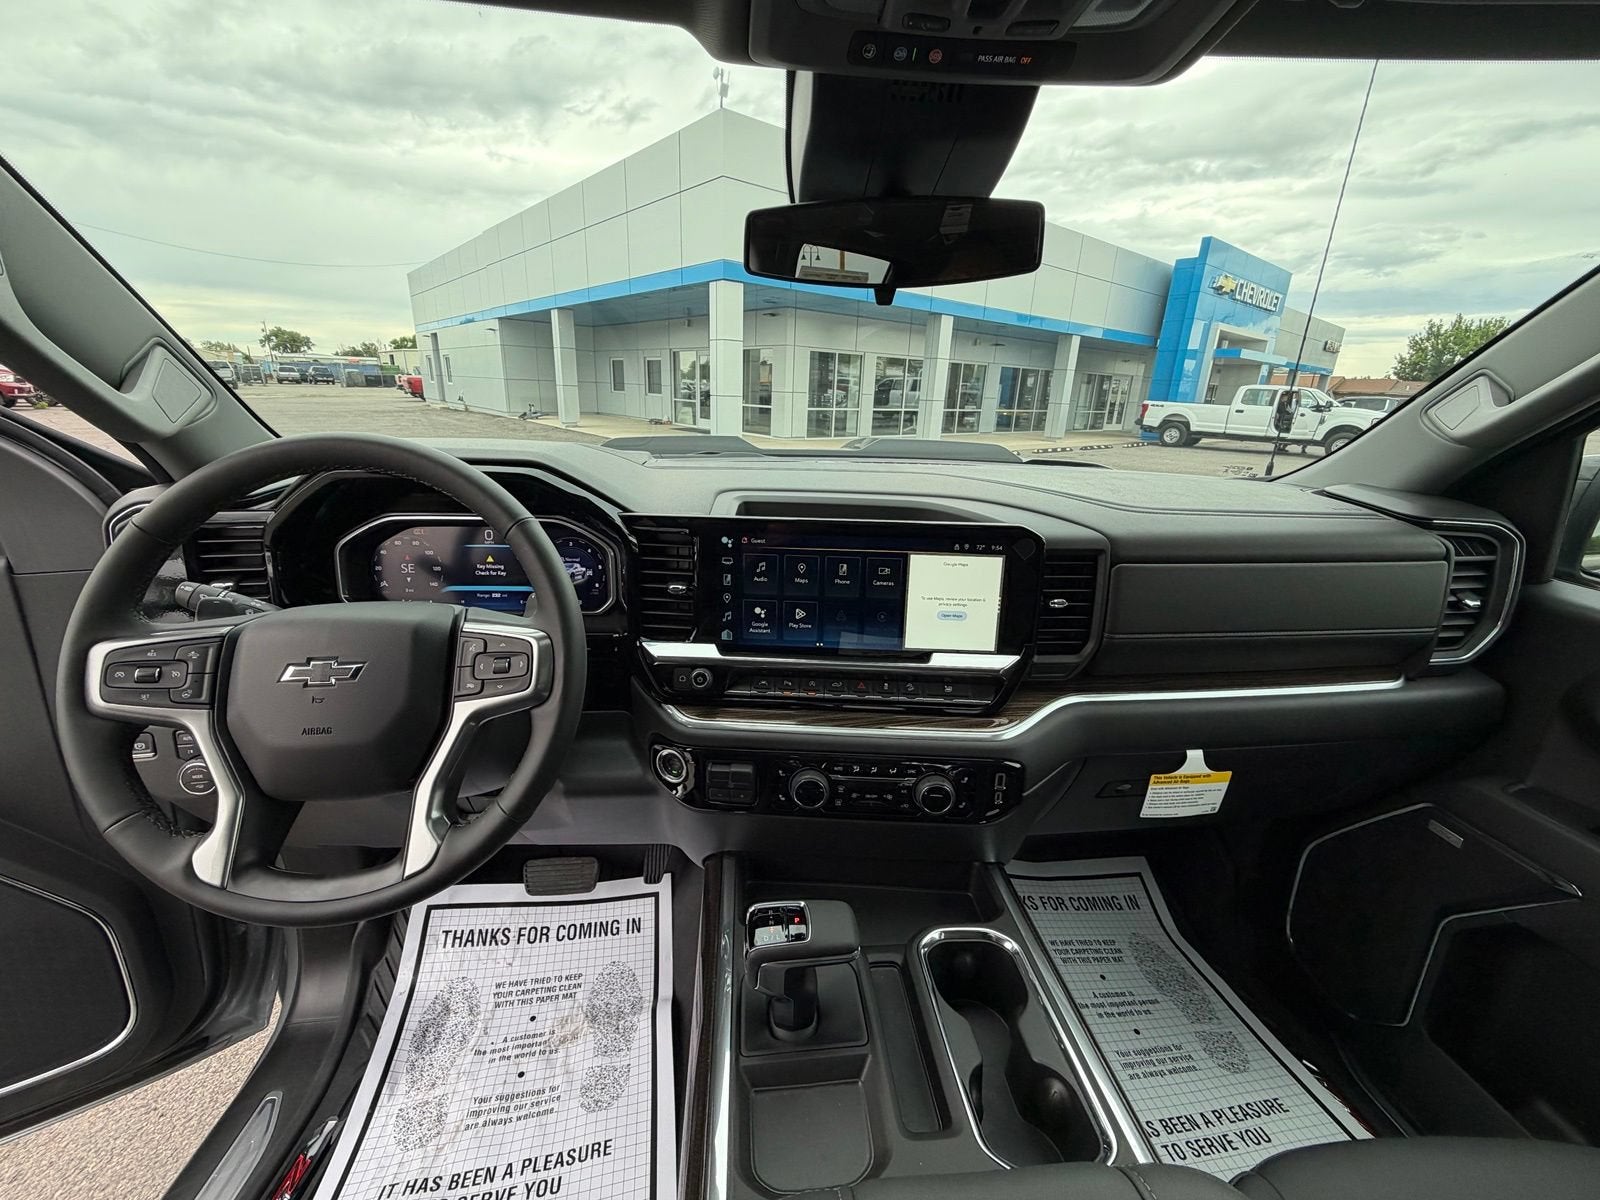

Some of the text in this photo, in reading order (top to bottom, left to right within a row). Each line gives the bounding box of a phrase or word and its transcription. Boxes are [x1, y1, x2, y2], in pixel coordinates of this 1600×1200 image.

[1235, 279, 1283, 312] CHEVROLET
[485, 530, 493, 540] 0
[401, 564, 415, 574] SE
[302, 727, 333, 736] AIRBAG
[1039, 896, 1069, 911] FOR
[1068, 895, 1124, 912] COMING
[1123, 894, 1141, 910] IN
[442, 917, 642, 948] THANKS FOR COMING IN
[495, 973, 583, 989] WE HAVE TRIED TO KEEP
[493, 983, 583, 999] YOUR CARPETING CLEAN
[495, 992, 578, 1009] WITH THIS PAPER MAT
[511, 1031, 547, 1042] customer
[490, 1045, 510, 1055] most
[499, 1054, 513, 1062] the
[514, 1049, 537, 1059] world
[539, 1048, 548, 1056] to
[1128, 1073, 1142, 1081] are
[1141, 1070, 1168, 1079] always
[473, 1084, 561, 1105] Your suggestions for
[466, 1095, 561, 1119] improving our service
[465, 1122, 480, 1131] are
[482, 1116, 514, 1128] always
[1159, 1114, 1202, 1136] BEEN
[1200, 1112, 1216, 1129] A
[1212, 1098, 1290, 1126] PLEASURE
[1161, 1127, 1273, 1162] TO SERVE YOU
[377, 1139, 614, 1200] IT HAS BEEN A PLEASURE
[525, 1176, 563, 1200] YOU
